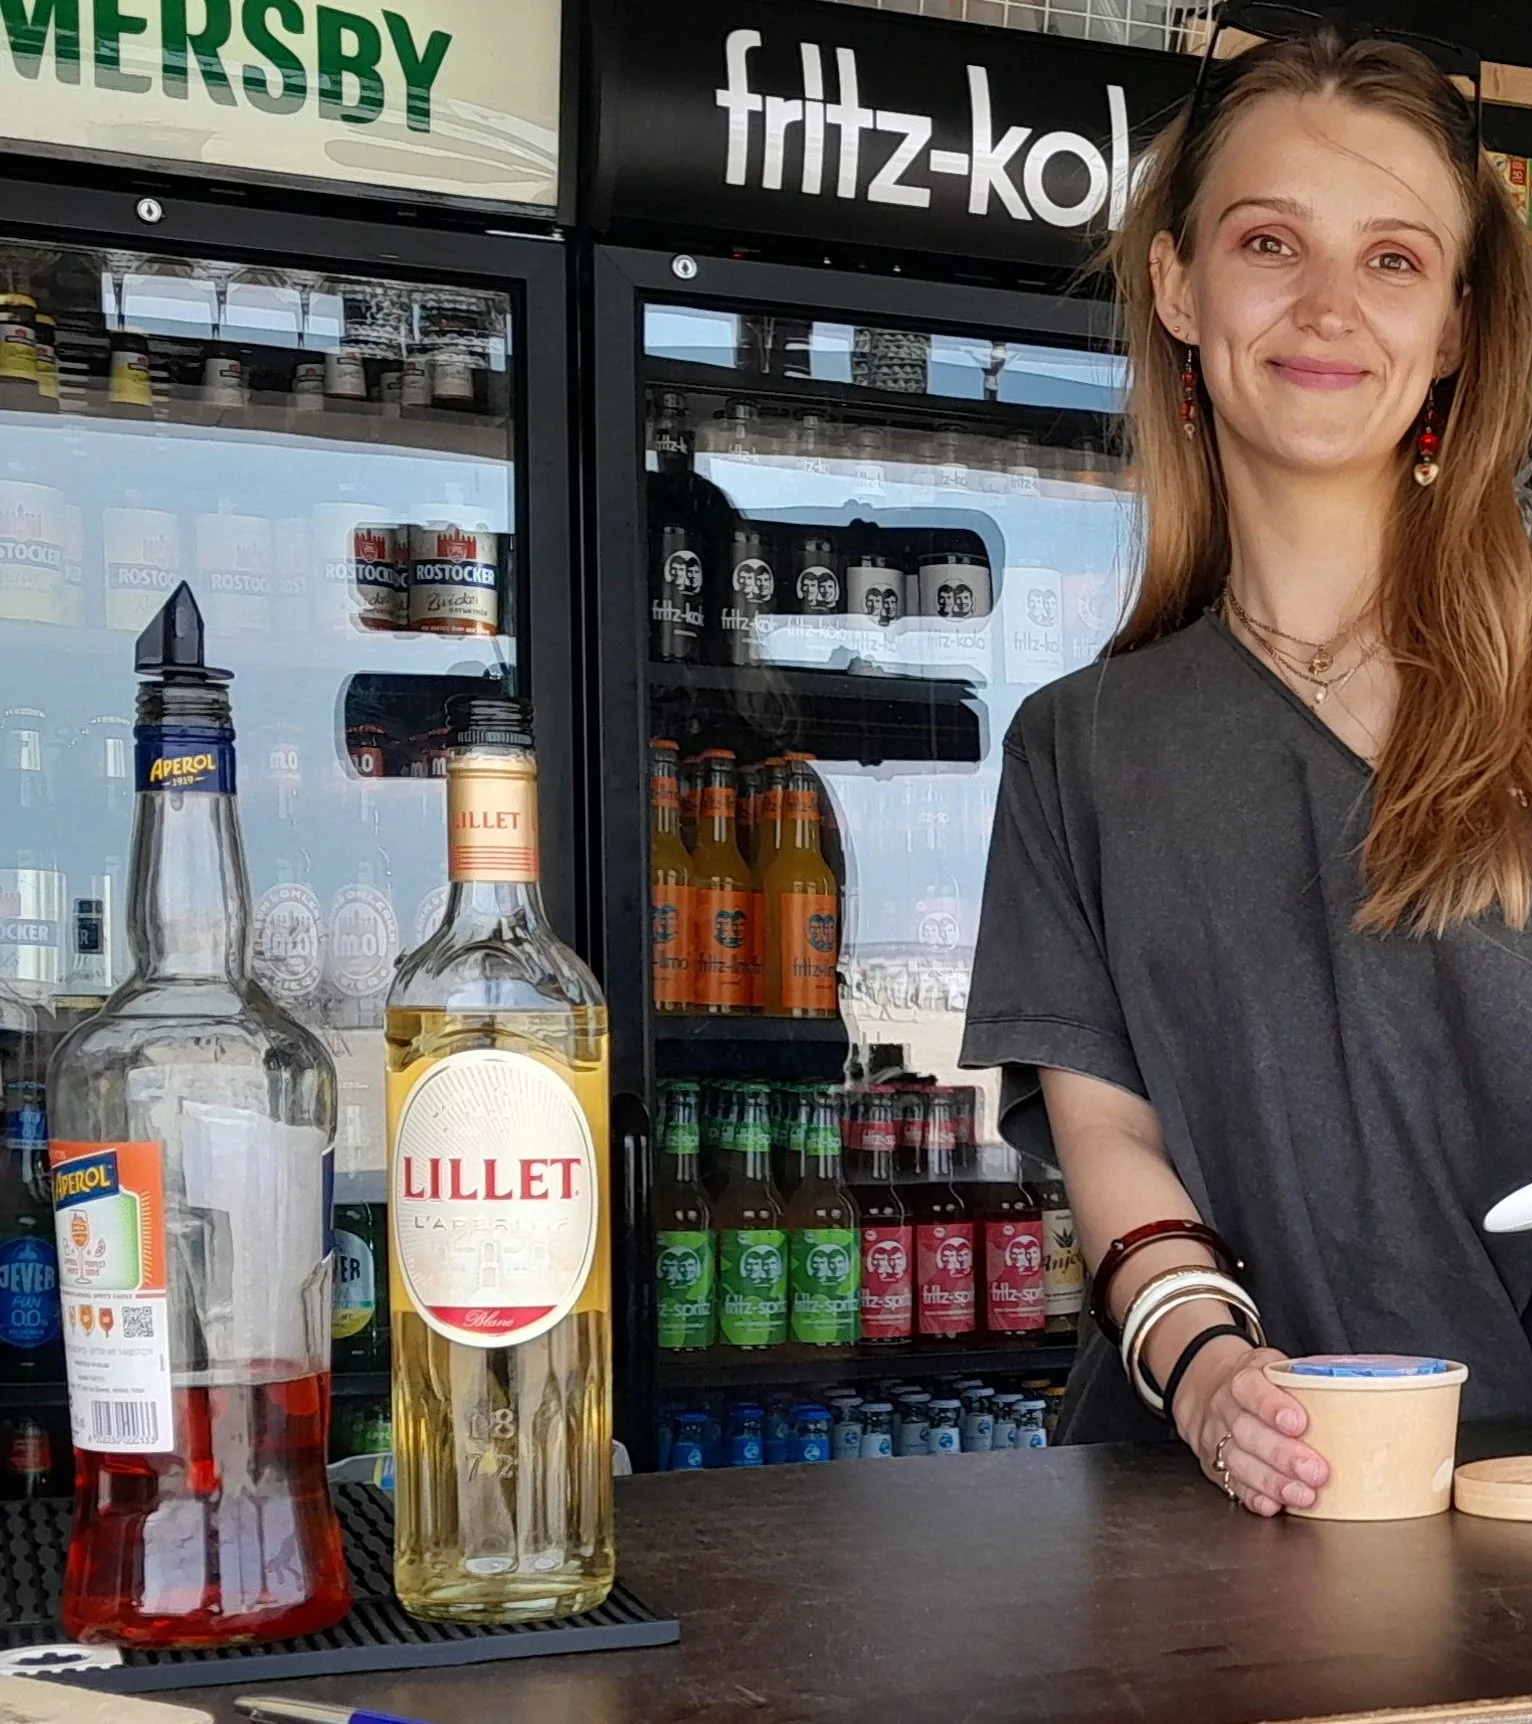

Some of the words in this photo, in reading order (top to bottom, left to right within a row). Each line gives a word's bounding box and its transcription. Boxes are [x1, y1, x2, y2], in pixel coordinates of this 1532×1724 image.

[0, 0, 453, 132] MERSBY
[716, 28, 1152, 232] fritz-kol
[416, 564, 496, 586] ROSTOCKER
[150, 753, 216, 782] APEROL
[171, 775, 195, 787] 1919
[55, 1165, 112, 1201] APEROL
[403, 1156, 582, 1201] LILLET
[0, 1261, 56, 1294] JEVER
